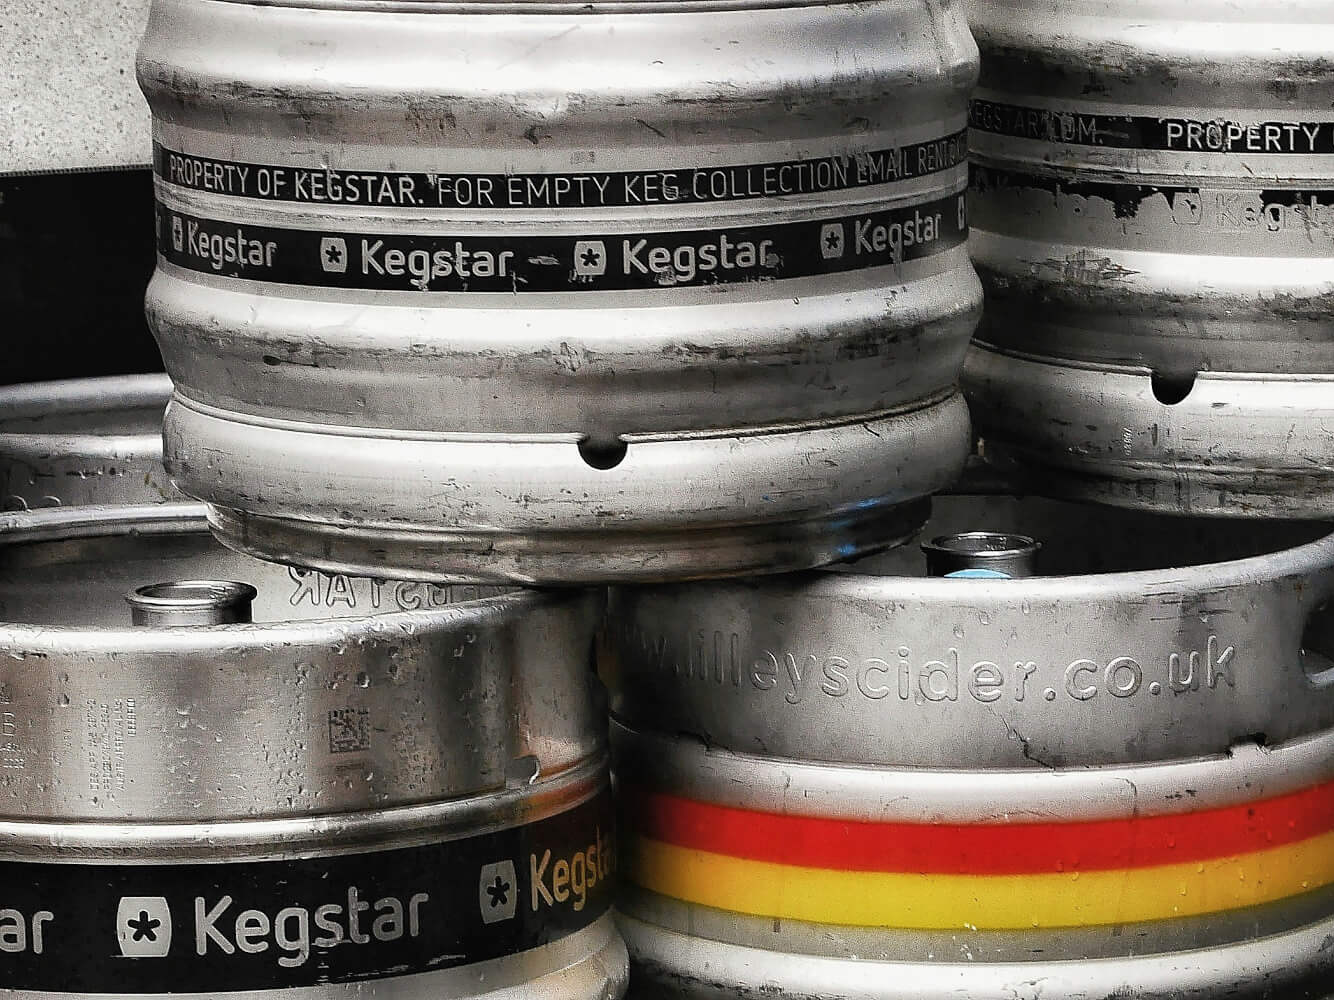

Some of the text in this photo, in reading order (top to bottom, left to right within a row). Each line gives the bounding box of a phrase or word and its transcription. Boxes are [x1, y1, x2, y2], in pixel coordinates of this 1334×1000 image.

[1166, 121, 1317, 151] PROPERTY
[169, 154, 249, 194] PROPERTY
[257, 168, 285, 197] OF
[295, 171, 424, 205] KEGSTAR.
[437, 176, 494, 206] FOR
[508, 174, 611, 207] EMPTY
[624, 173, 679, 204] KEG
[693, 160, 848, 200] COLLECTION
[856, 146, 913, 185] EMAIL
[187, 210, 942, 288] Kegstar Kegstar Kegstar Kegstar
[194, 886, 430, 968] Kegstar
